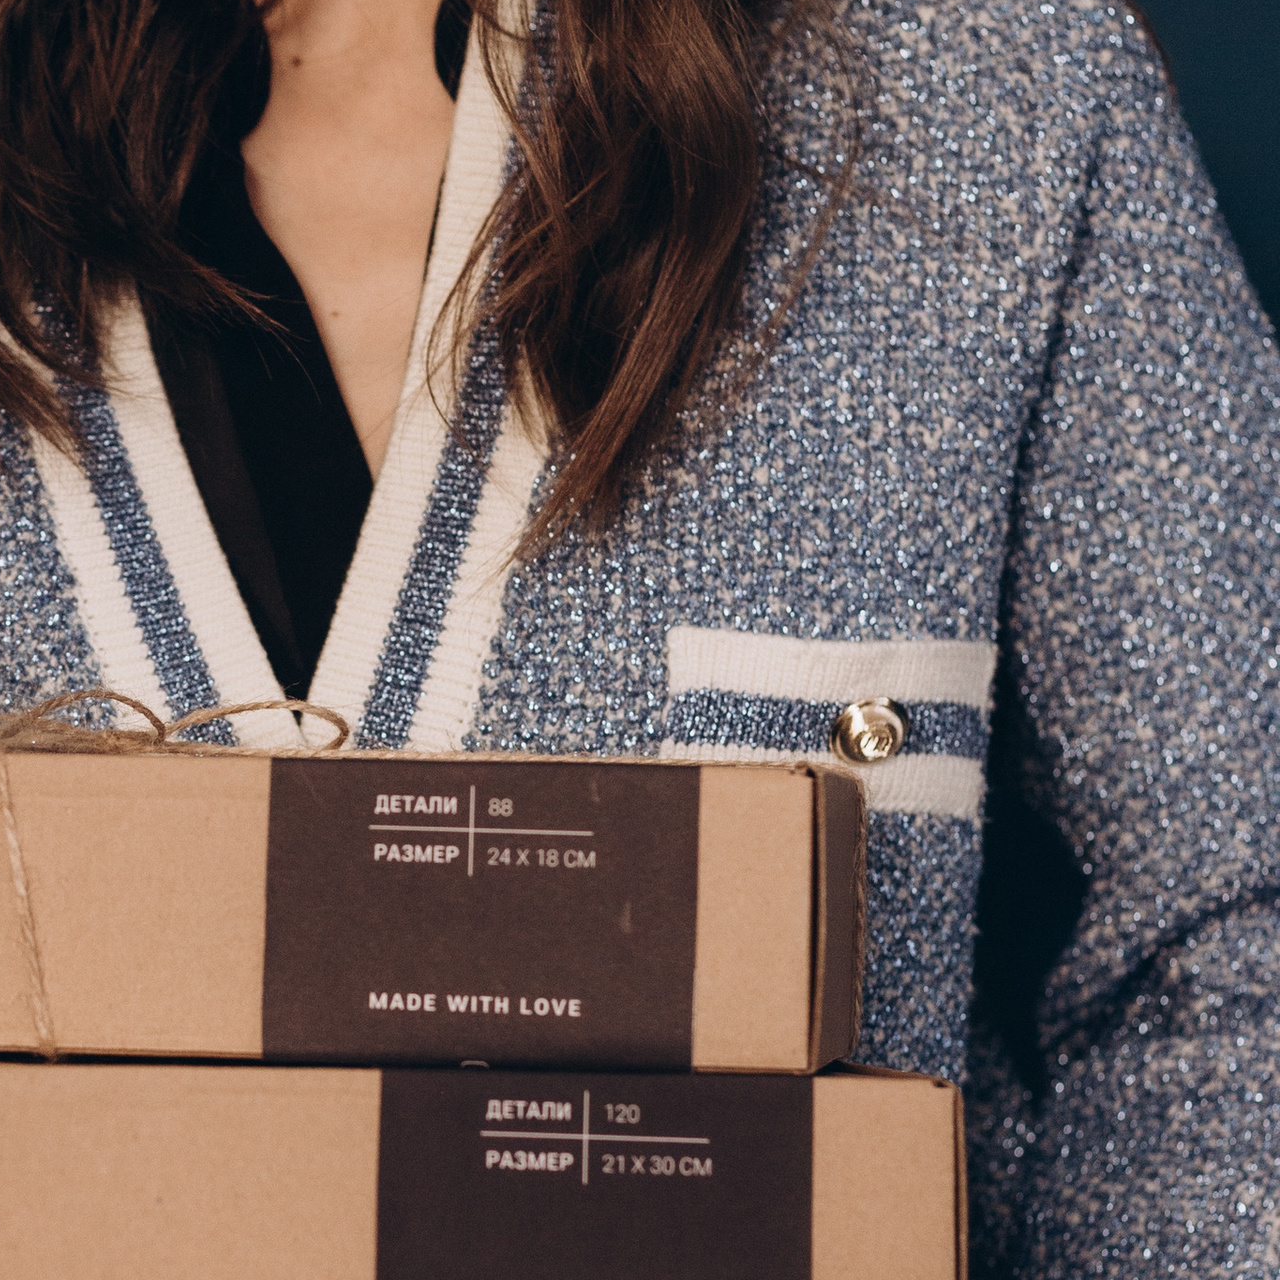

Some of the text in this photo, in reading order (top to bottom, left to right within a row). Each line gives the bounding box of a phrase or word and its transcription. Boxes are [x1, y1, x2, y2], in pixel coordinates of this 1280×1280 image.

[374, 794, 514, 818] ДЕТАЛИ 88
[373, 843, 460, 864] РАЗМЕР
[487, 846, 511, 866] 24
[537, 848, 560, 868] 18
[368, 991, 582, 1017] MADE WITH LOVE
[485, 1099, 641, 1125] ДЕТАЛИ 120
[485, 1149, 574, 1172] РАЗМЕР
[601, 1153, 626, 1174] 21
[649, 1154, 676, 1176] 30
